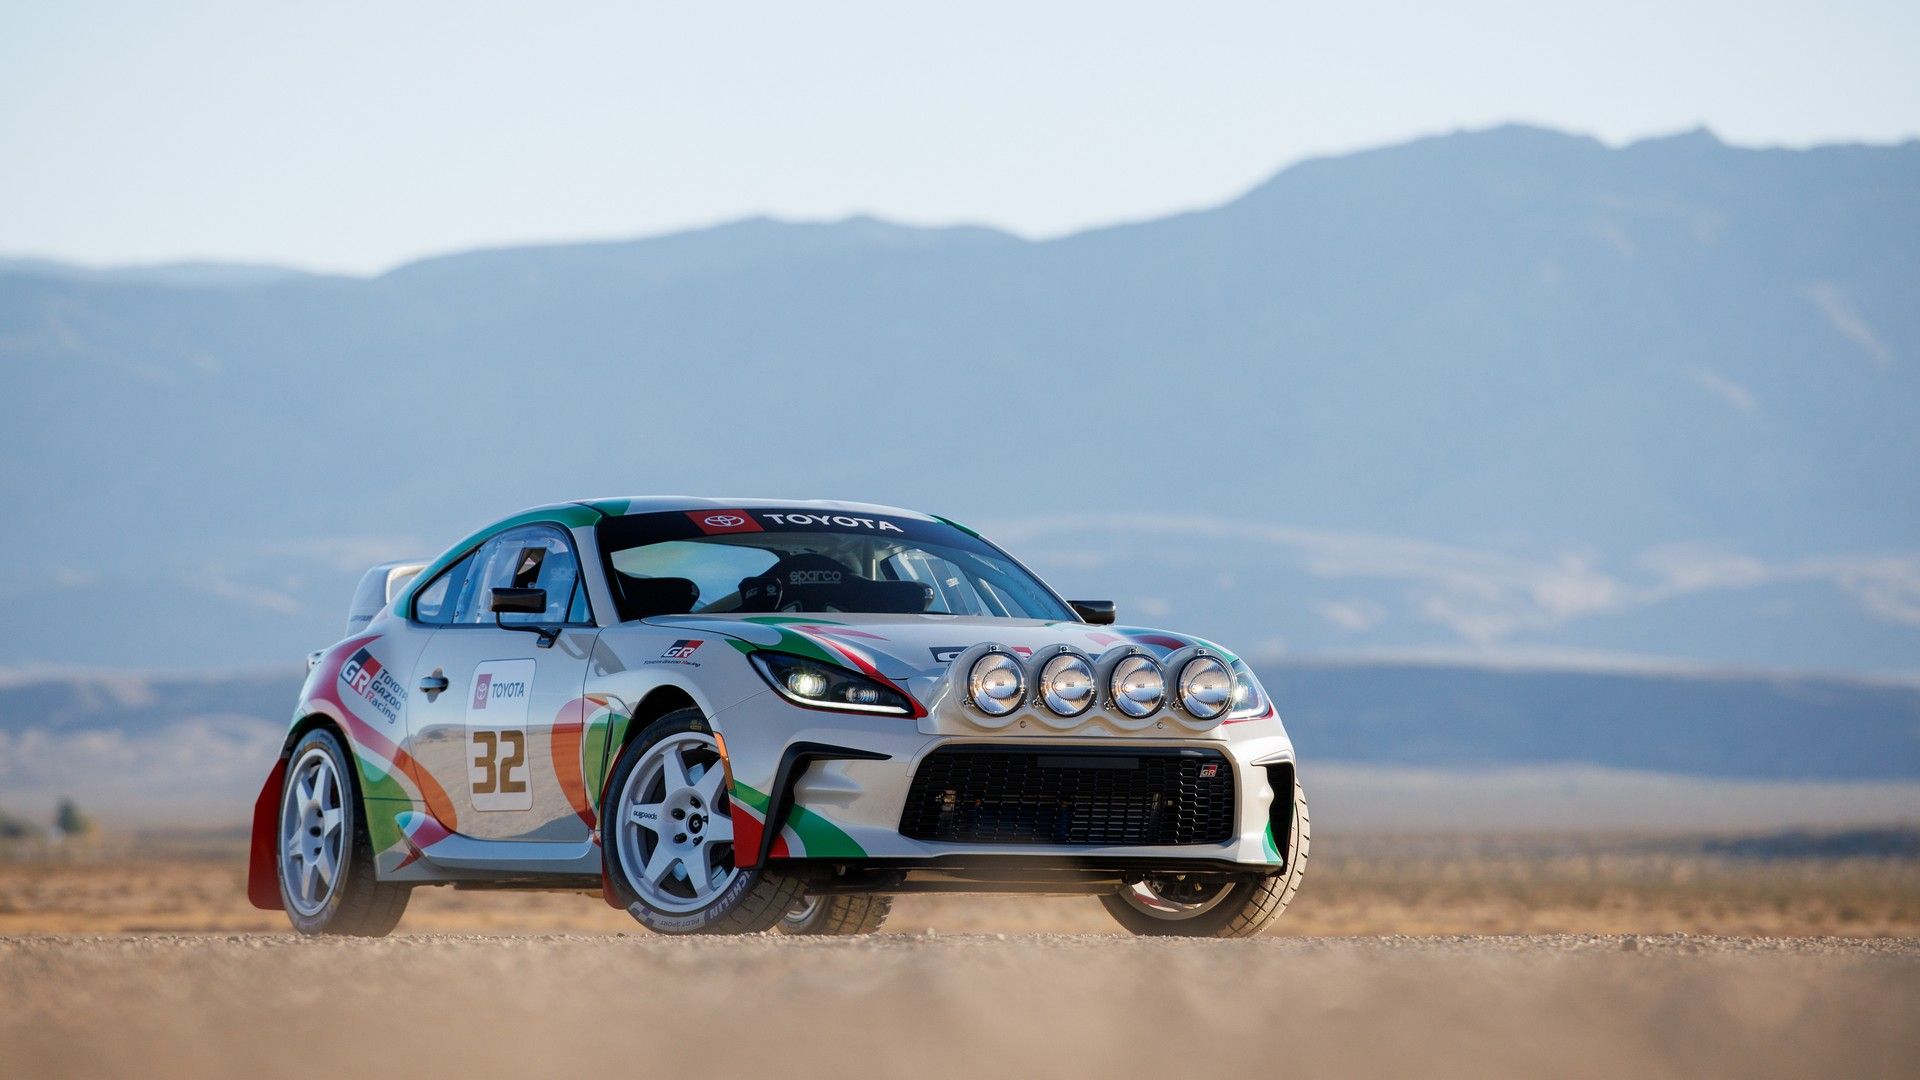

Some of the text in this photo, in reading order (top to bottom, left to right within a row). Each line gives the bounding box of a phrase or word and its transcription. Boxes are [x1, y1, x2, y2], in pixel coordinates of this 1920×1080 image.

[763, 514, 904, 532] TOYOTA
[342, 660, 371, 694] GR
[380, 669, 409, 701] TOYOTA
[492, 682, 525, 698] TOYOTA
[364, 691, 397, 724] Racing
[371, 680, 402, 711] GAZOO
[473, 730, 526, 794] 32
